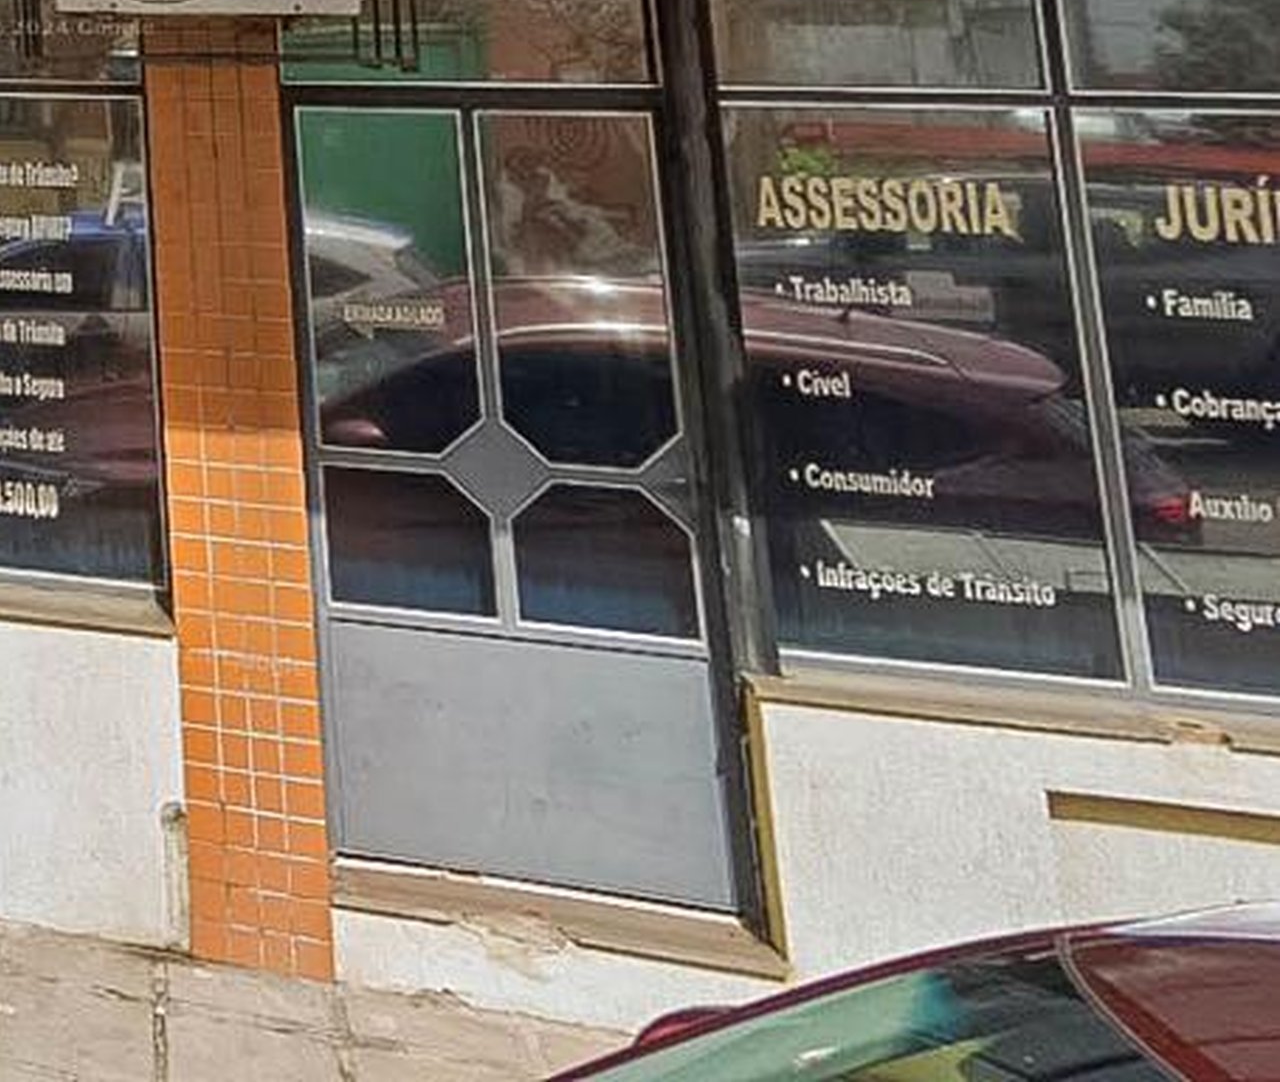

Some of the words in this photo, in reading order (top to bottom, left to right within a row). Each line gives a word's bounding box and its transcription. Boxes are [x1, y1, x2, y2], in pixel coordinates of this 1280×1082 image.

[757, 175, 1010, 235] ASSESSORIA
[1155, 175, 1280, 245] JURÍ
[789, 275, 913, 306] Trabalhista
[804, 462, 935, 498] Consumidor
[926, 571, 955, 598] de
